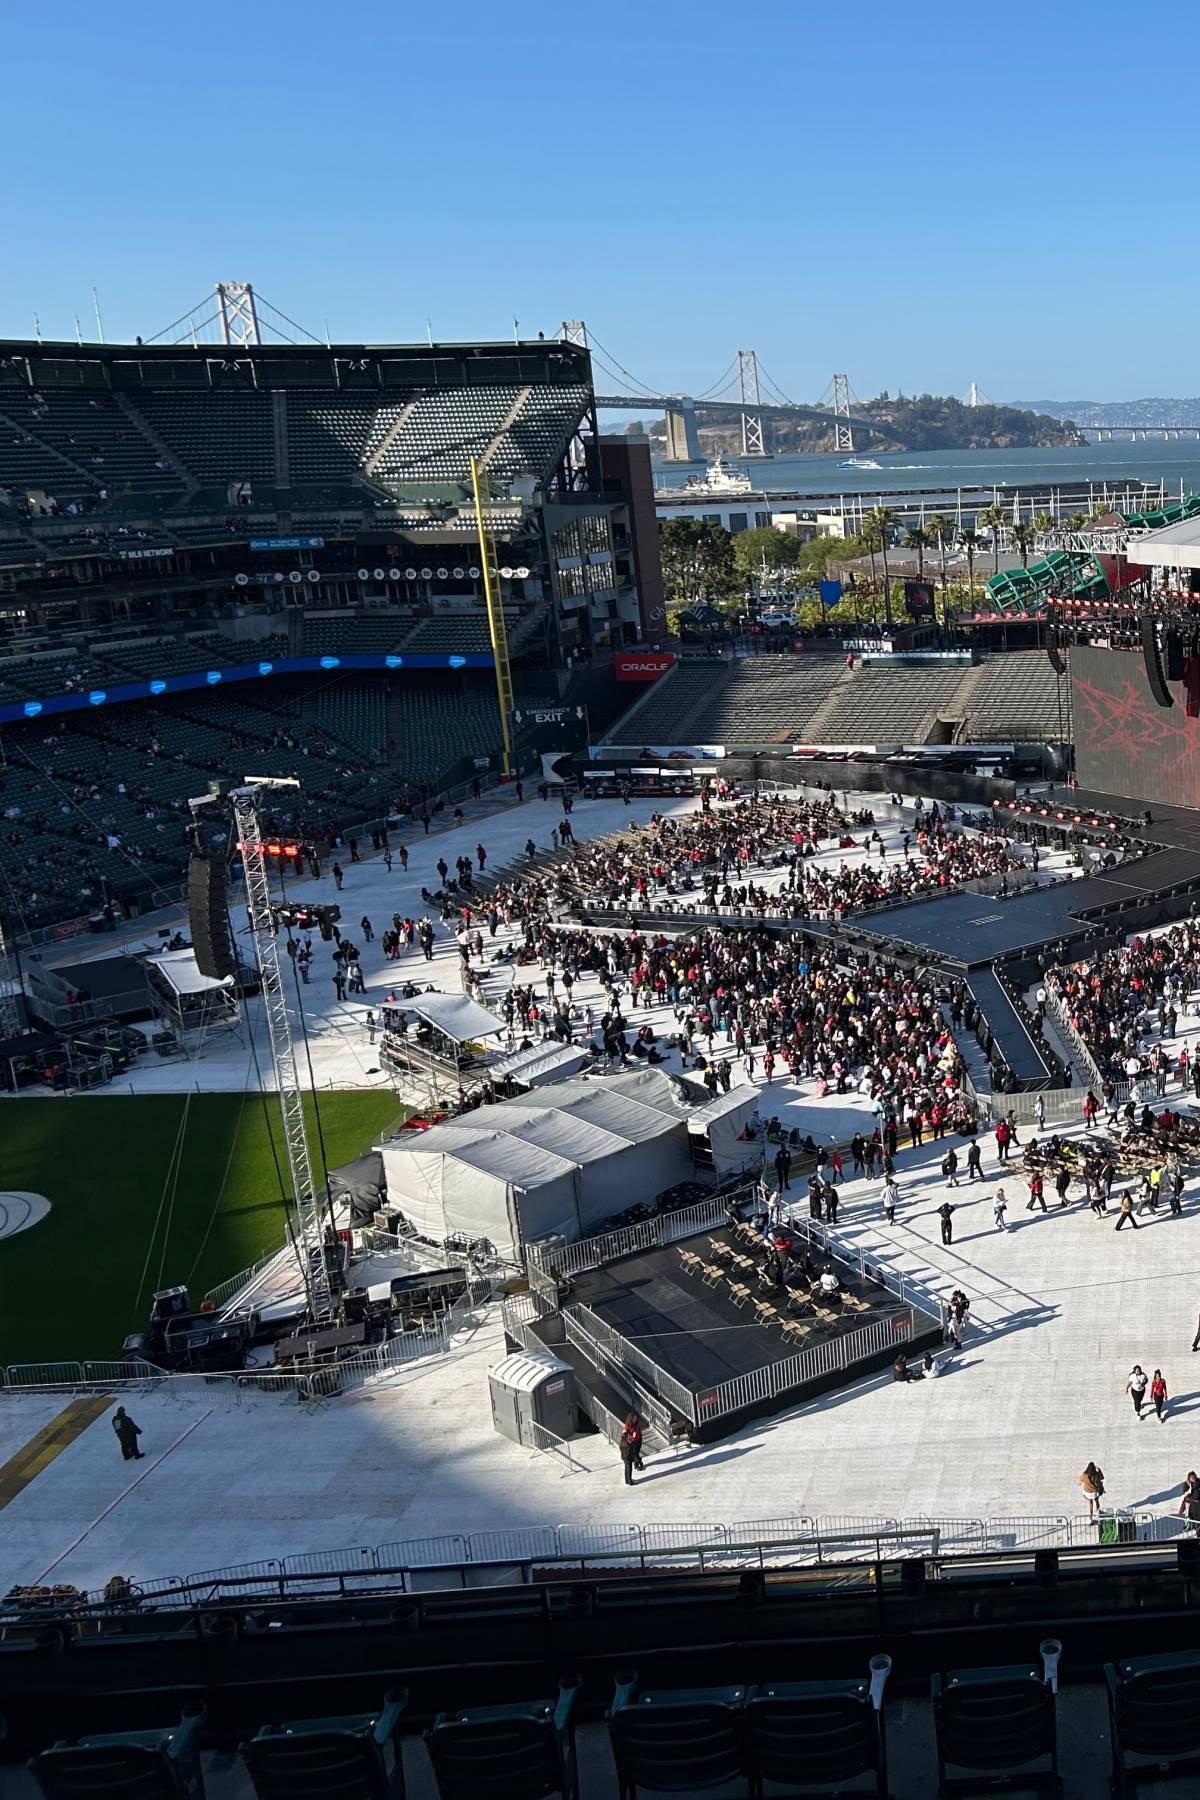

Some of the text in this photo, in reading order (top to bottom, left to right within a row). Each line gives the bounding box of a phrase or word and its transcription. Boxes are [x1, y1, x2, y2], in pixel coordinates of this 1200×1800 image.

[755, 580, 815, 605] blue
[621, 663, 668, 671] ORACLE
[535, 713, 562, 722] EXIT
